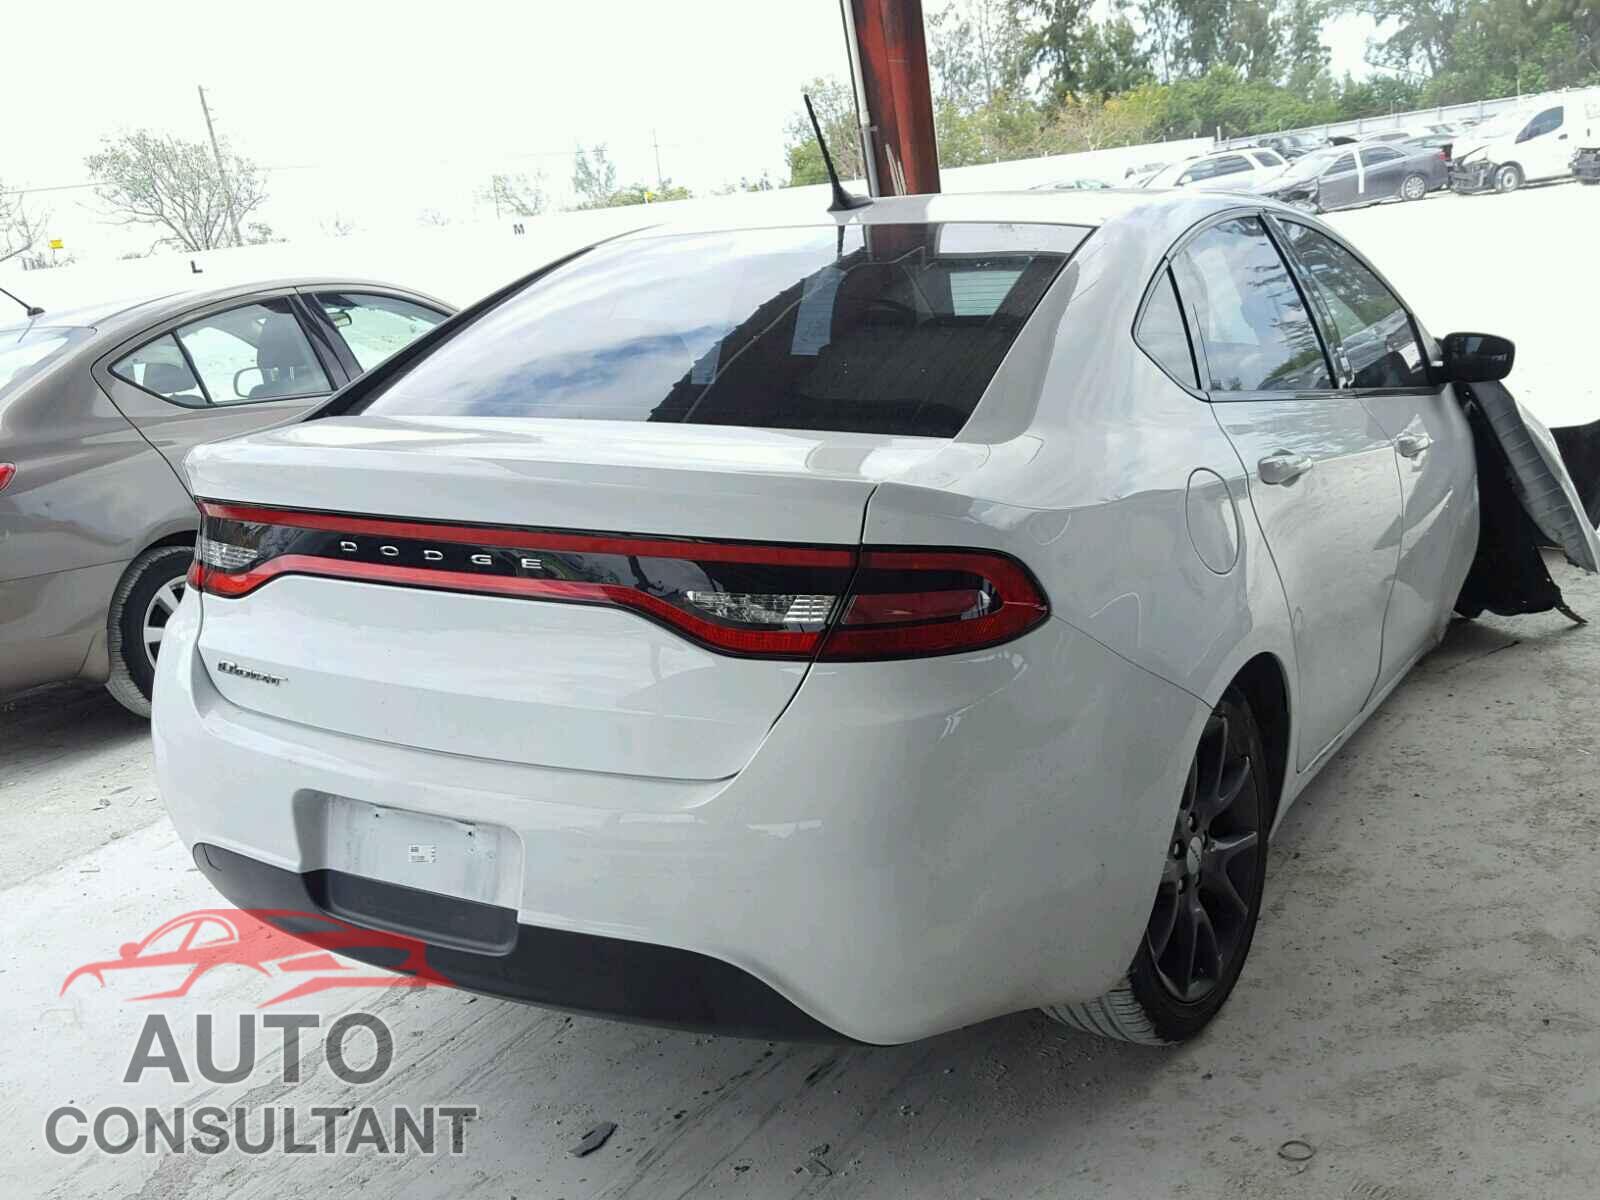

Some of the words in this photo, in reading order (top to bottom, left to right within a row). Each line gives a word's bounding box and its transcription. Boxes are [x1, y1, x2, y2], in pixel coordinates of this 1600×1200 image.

[513, 223, 525, 235] M
[190, 260, 203, 274] L
[339, 540, 543, 569] DODGE
